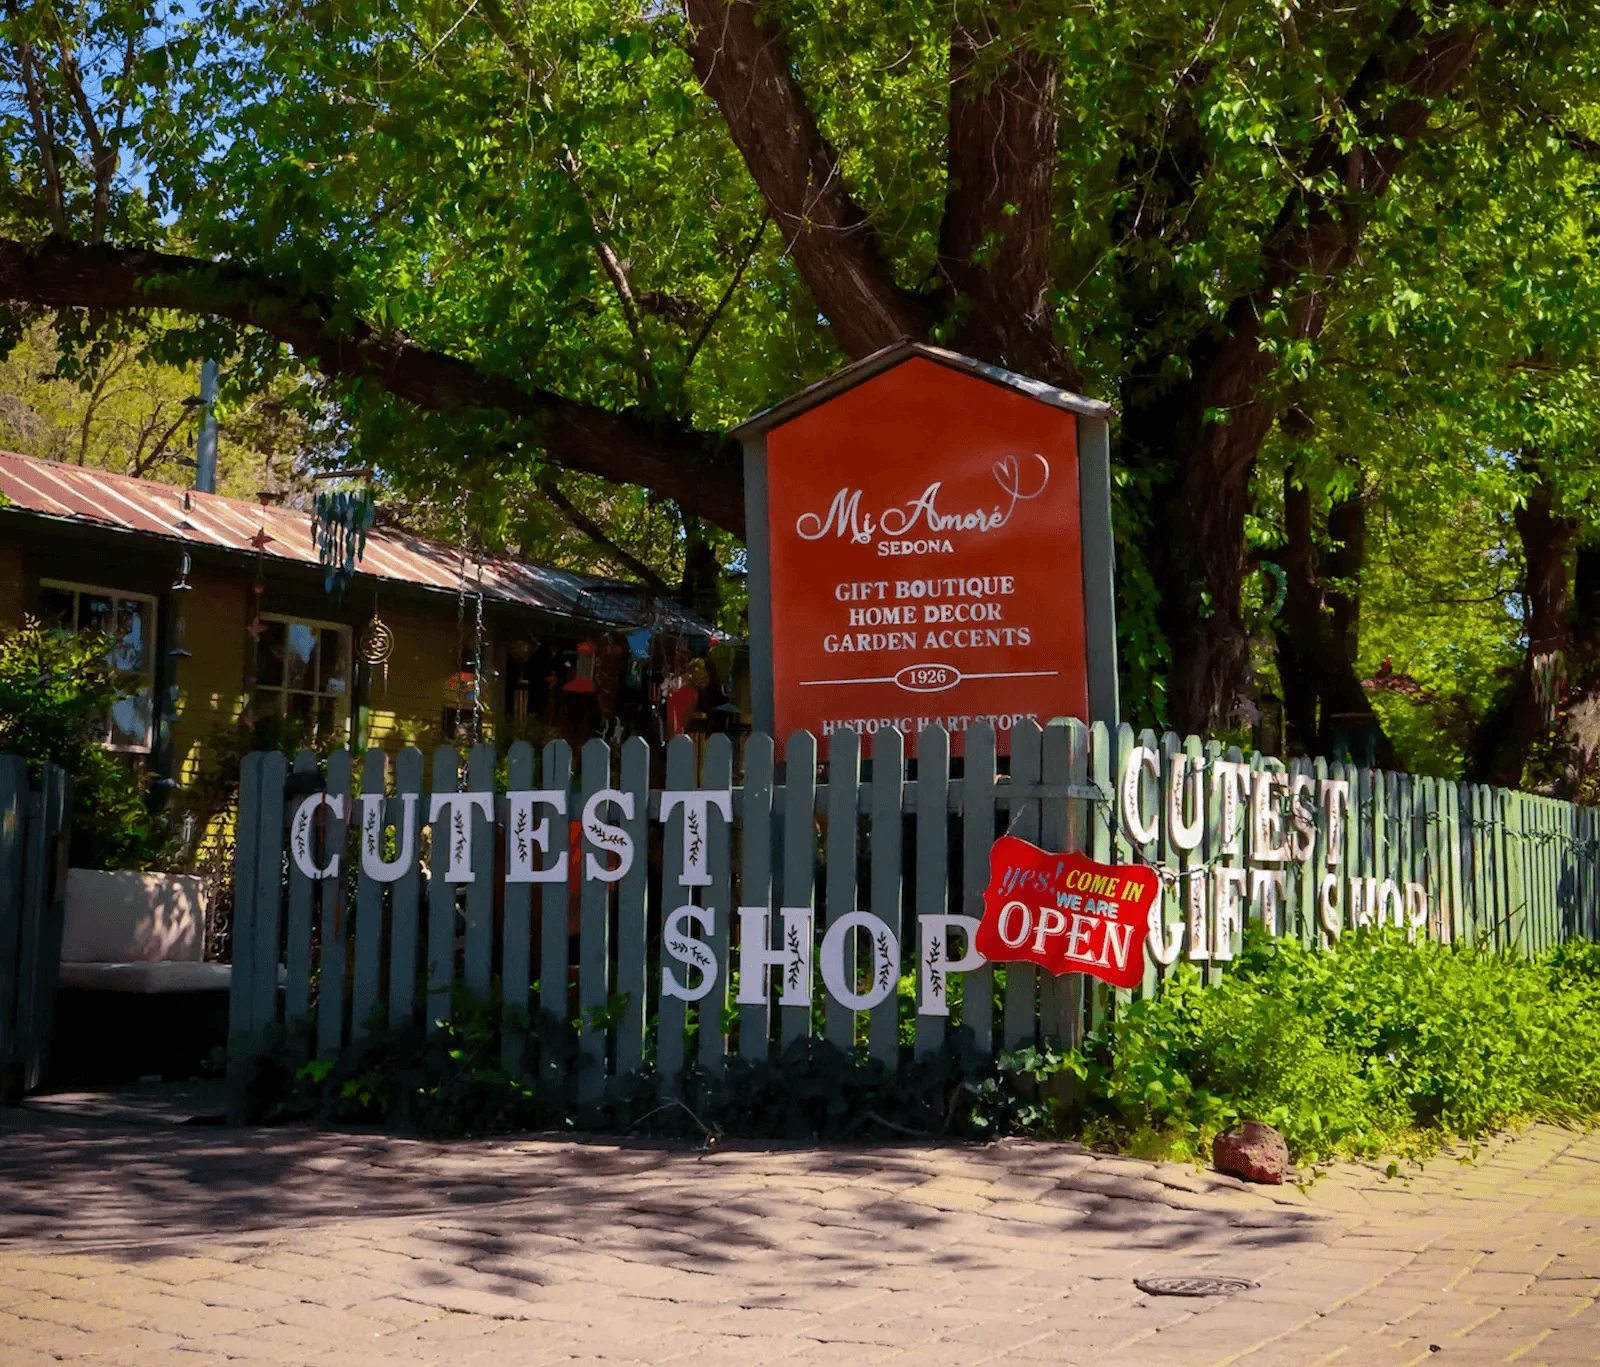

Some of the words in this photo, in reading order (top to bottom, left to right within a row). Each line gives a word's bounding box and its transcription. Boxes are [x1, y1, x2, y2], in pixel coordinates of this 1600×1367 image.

[796, 488, 876, 544] Mi
[880, 482, 1016, 534] Amoré
[877, 539, 954, 556] SEDONA
[835, 581, 889, 601] GIFT
[895, 576, 1015, 599] BOUTIQUE
[849, 607, 917, 626] HOME
[923, 603, 1003, 624] DECOR
[823, 632, 917, 653] GARDEN
[923, 627, 1032, 649] ACCENTS
[909, 670, 947, 685] 1926
[917, 715, 971, 733] HART
[974, 713, 1038, 731] TOR
[1122, 746, 1349, 866] CUTEST
[290, 789, 733, 886] CUTEST
[998, 861, 1064, 897] yes!
[1065, 869, 1121, 898] COME
[1120, 880, 1145, 903] IN
[1056, 891, 1082, 912] WE
[1083, 897, 1119, 919] ARE
[1147, 864, 1287, 966] GIFT
[1319, 873, 1428, 951] SHOP
[997, 900, 1135, 972] OPEN
[661, 904, 987, 1017] SHOP
